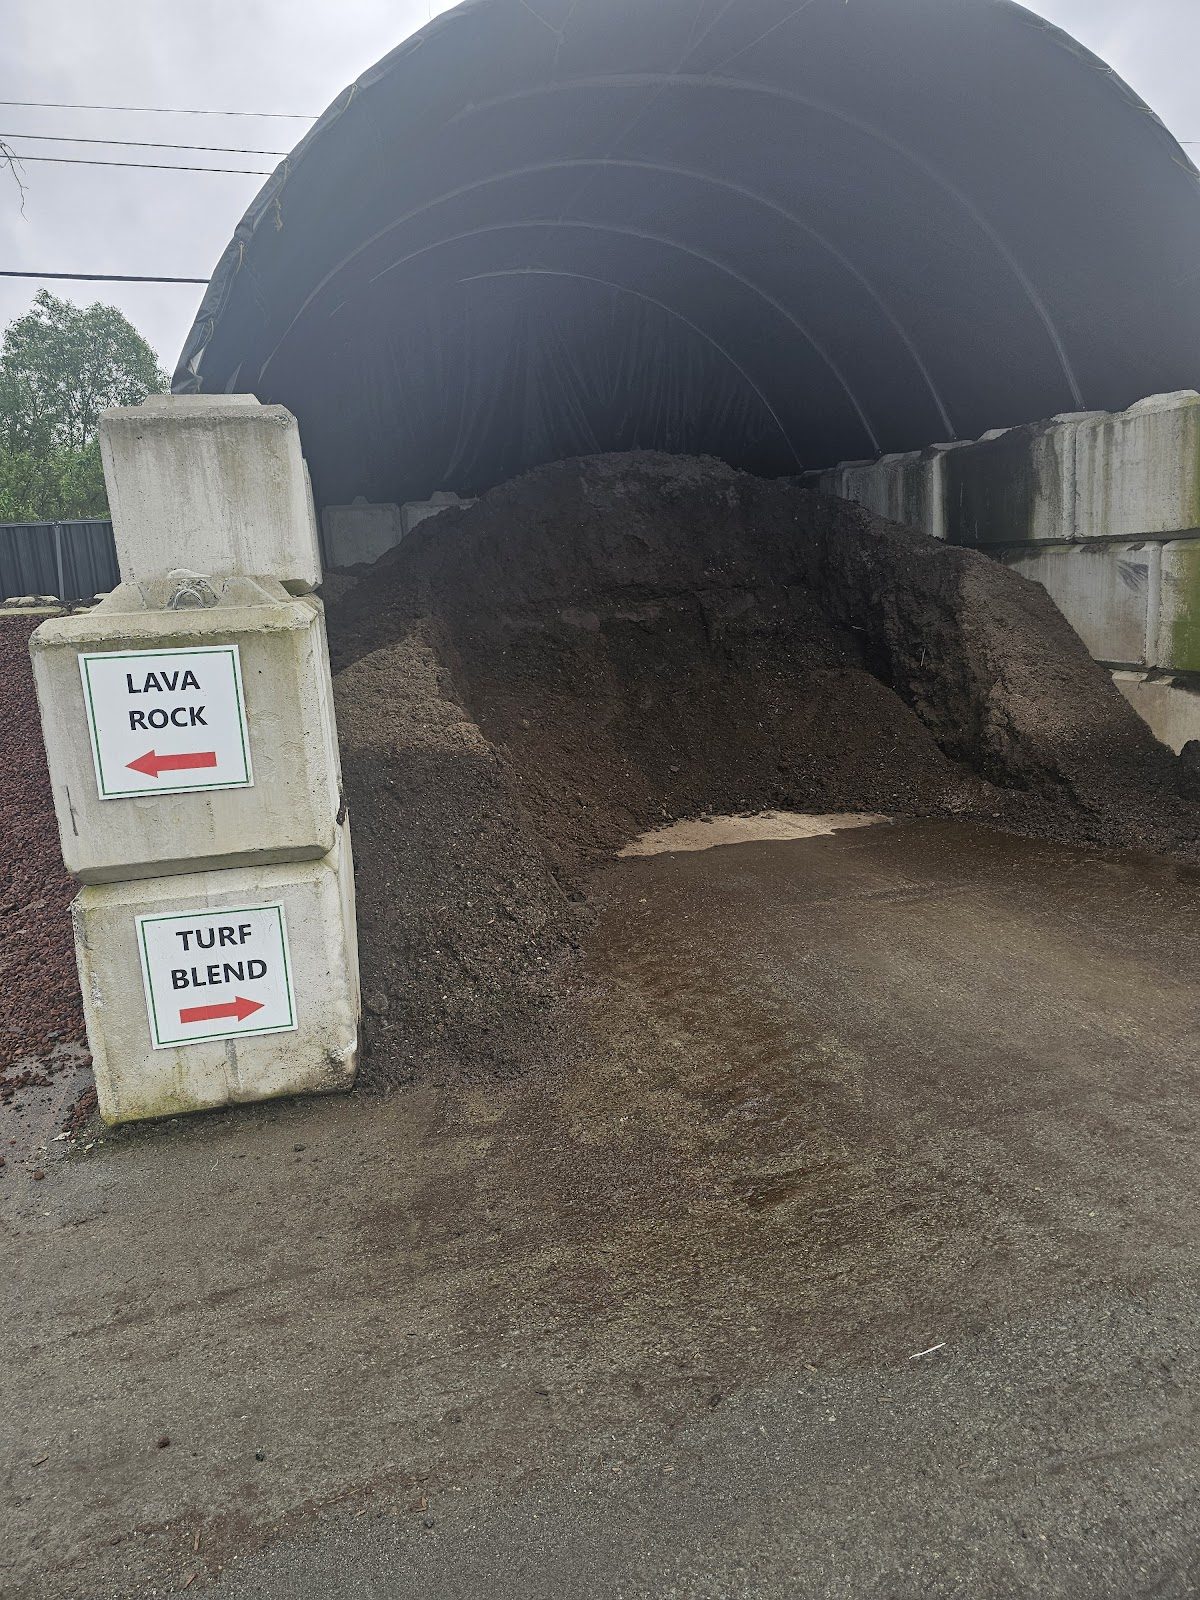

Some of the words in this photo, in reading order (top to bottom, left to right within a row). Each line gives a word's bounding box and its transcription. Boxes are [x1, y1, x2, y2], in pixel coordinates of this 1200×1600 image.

[126, 670, 201, 694] LAVA
[128, 705, 209, 731] ROCK
[175, 923, 252, 952] TURF
[170, 959, 268, 990] BLEND
